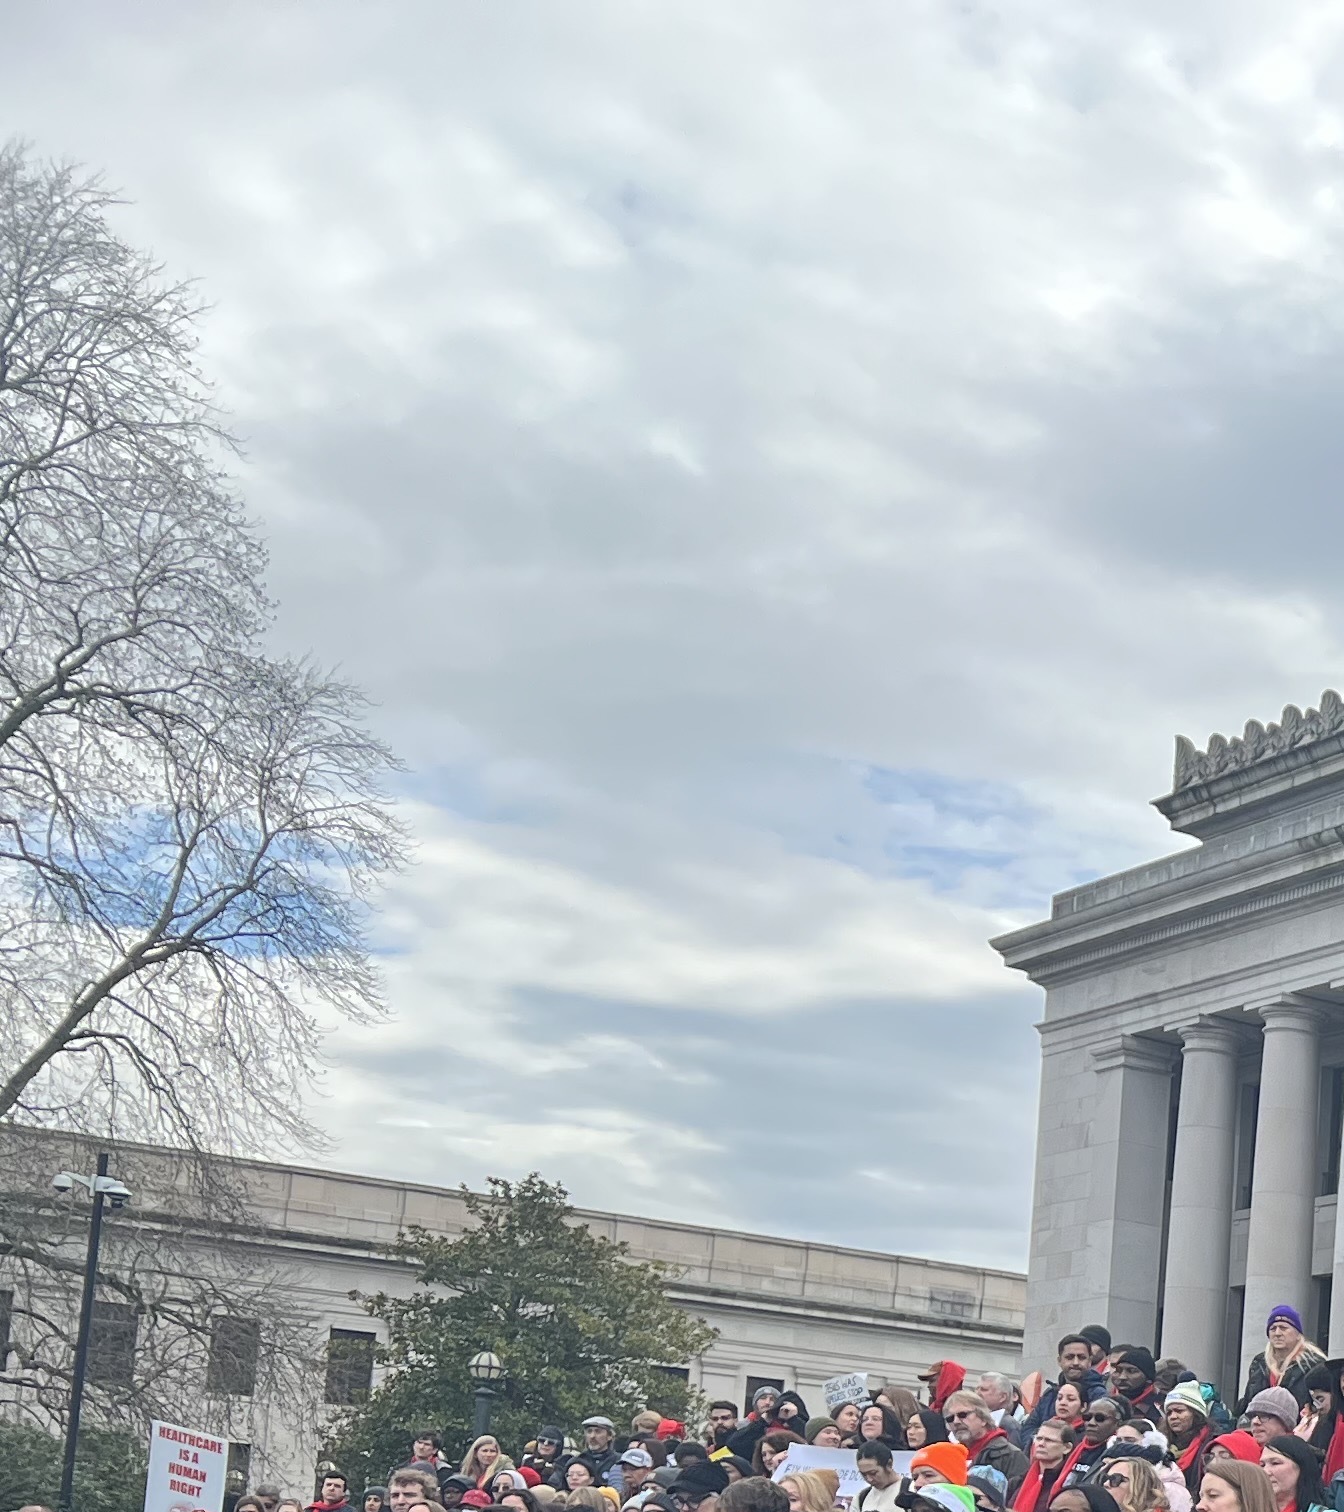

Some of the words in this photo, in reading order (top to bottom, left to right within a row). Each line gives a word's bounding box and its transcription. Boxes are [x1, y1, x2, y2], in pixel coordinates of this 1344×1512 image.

[159, 1426, 223, 1454] HEALTHCARE
[179, 1449, 189, 1461] IS
[192, 1452, 199, 1464] A
[168, 1462, 207, 1483] HUMAN
[169, 1479, 202, 1498] RIGHT
